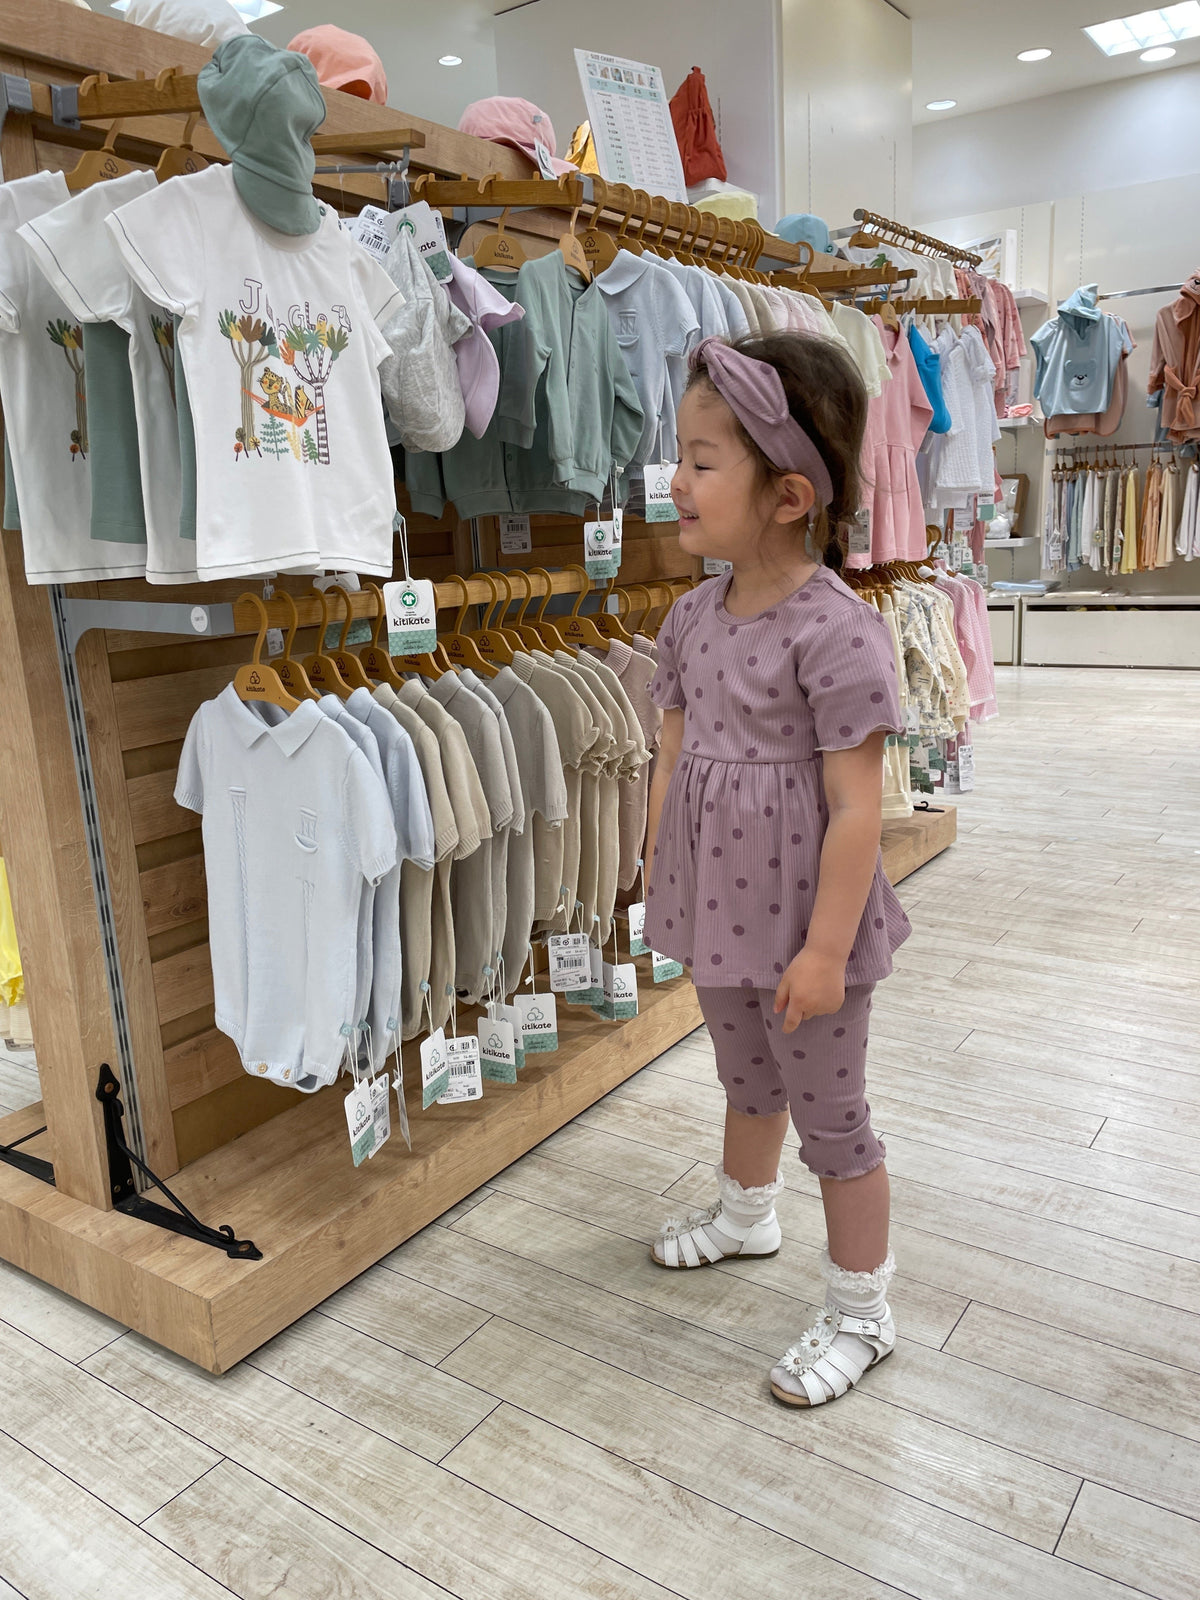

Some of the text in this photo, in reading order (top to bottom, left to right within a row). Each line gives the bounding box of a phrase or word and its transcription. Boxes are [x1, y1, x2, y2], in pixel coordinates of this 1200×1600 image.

[393, 617, 430, 627] kitikate
[482, 1047, 511, 1059] kitikate
[425, 1061, 446, 1080] kitikate
[352, 1114, 371, 1138] kitikate
